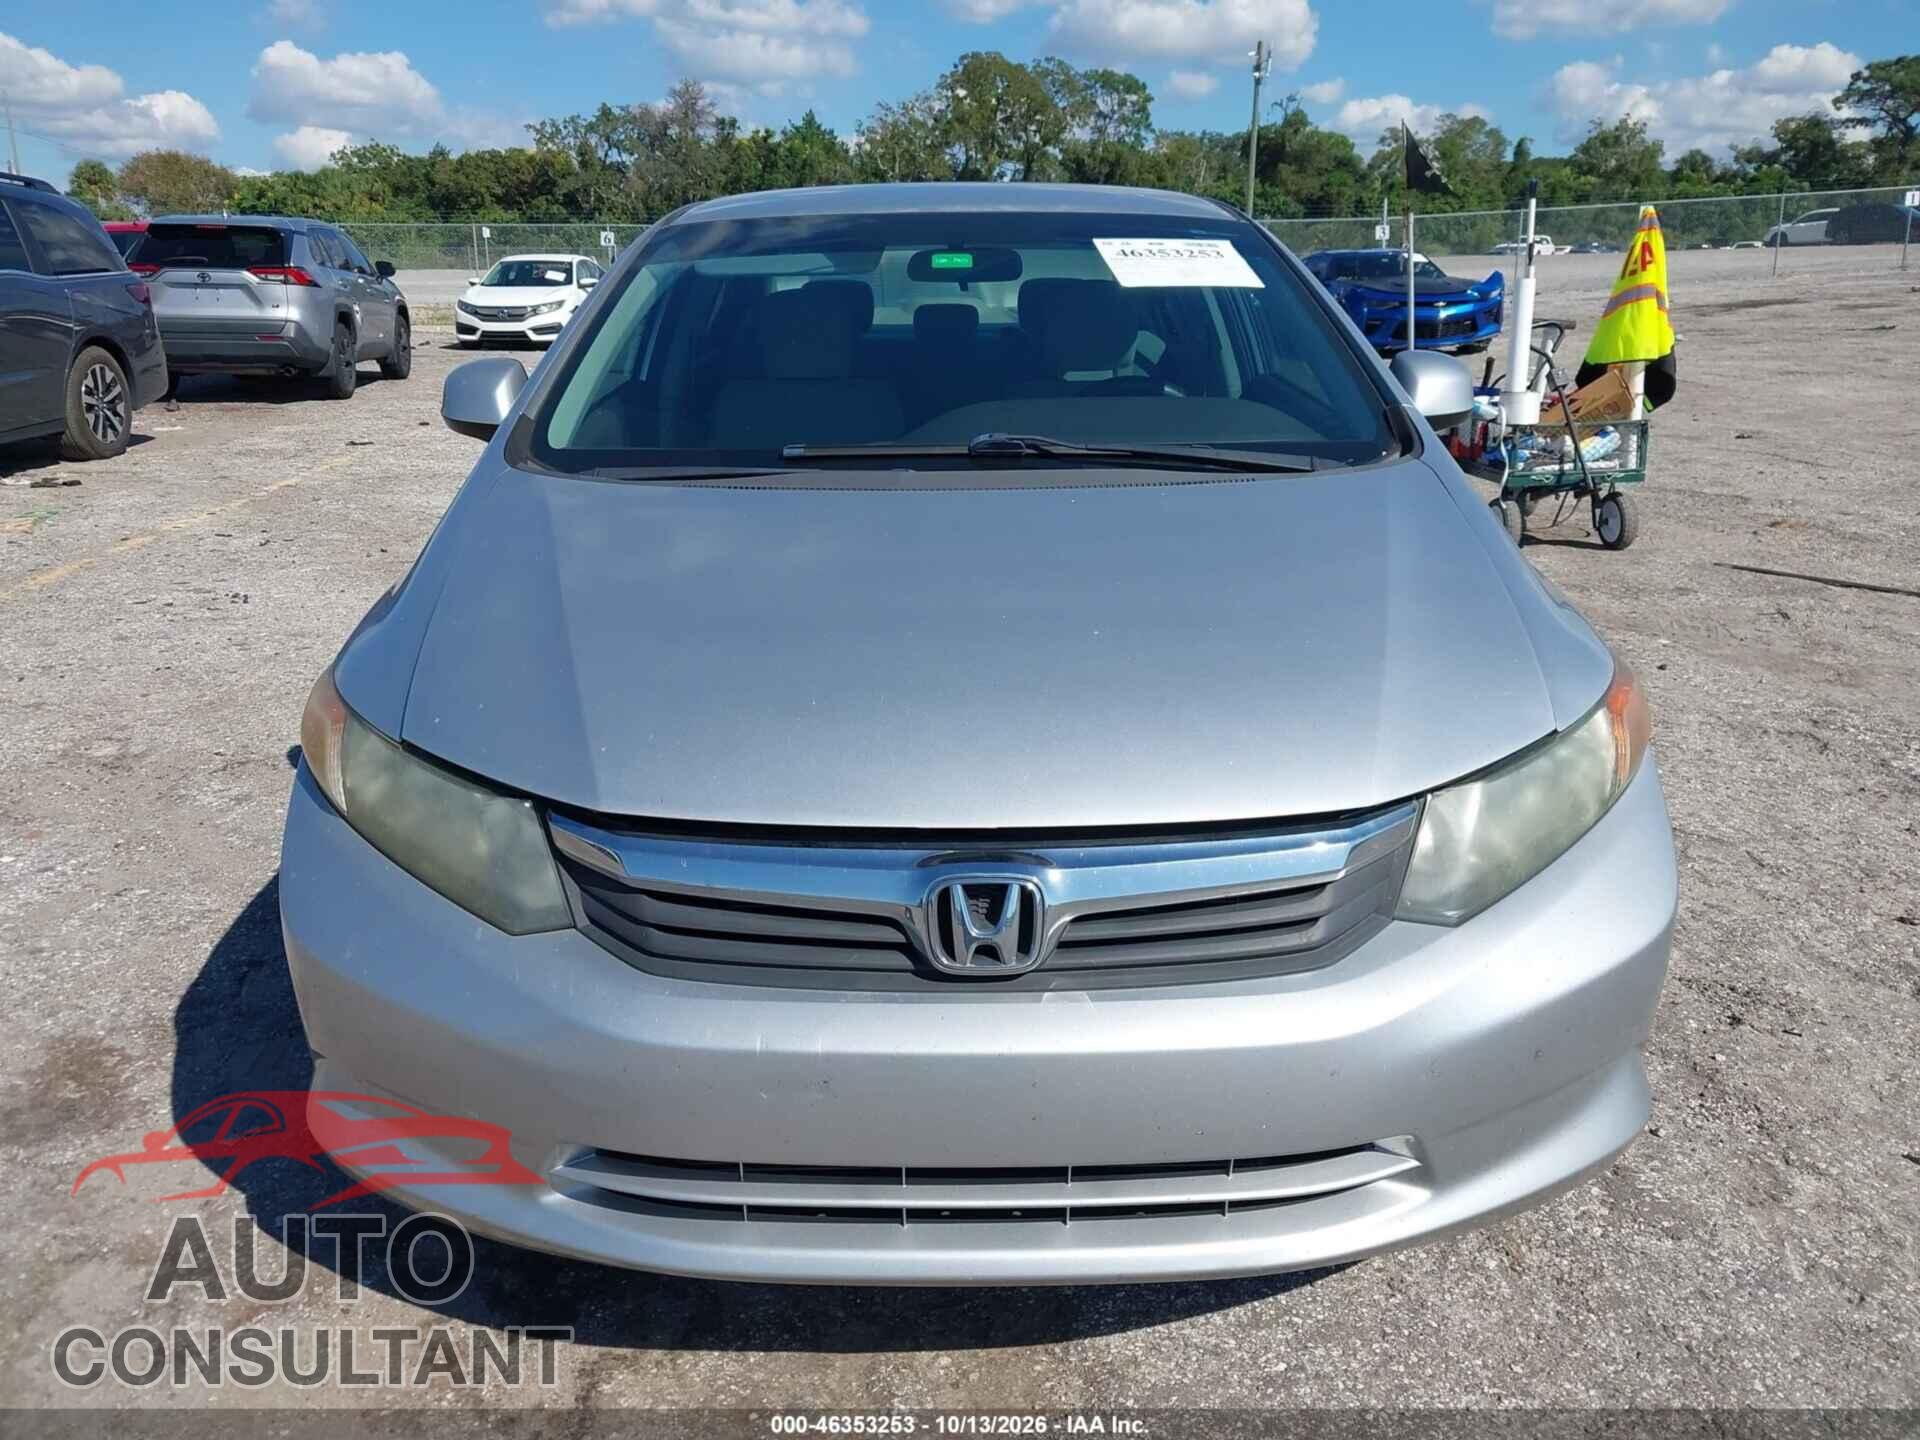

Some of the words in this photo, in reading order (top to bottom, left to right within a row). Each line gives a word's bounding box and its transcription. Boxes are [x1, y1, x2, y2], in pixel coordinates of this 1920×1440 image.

[1379, 226, 1386, 239] 3
[603, 234, 612, 244] 6
[1116, 249, 1225, 258] 46353253
